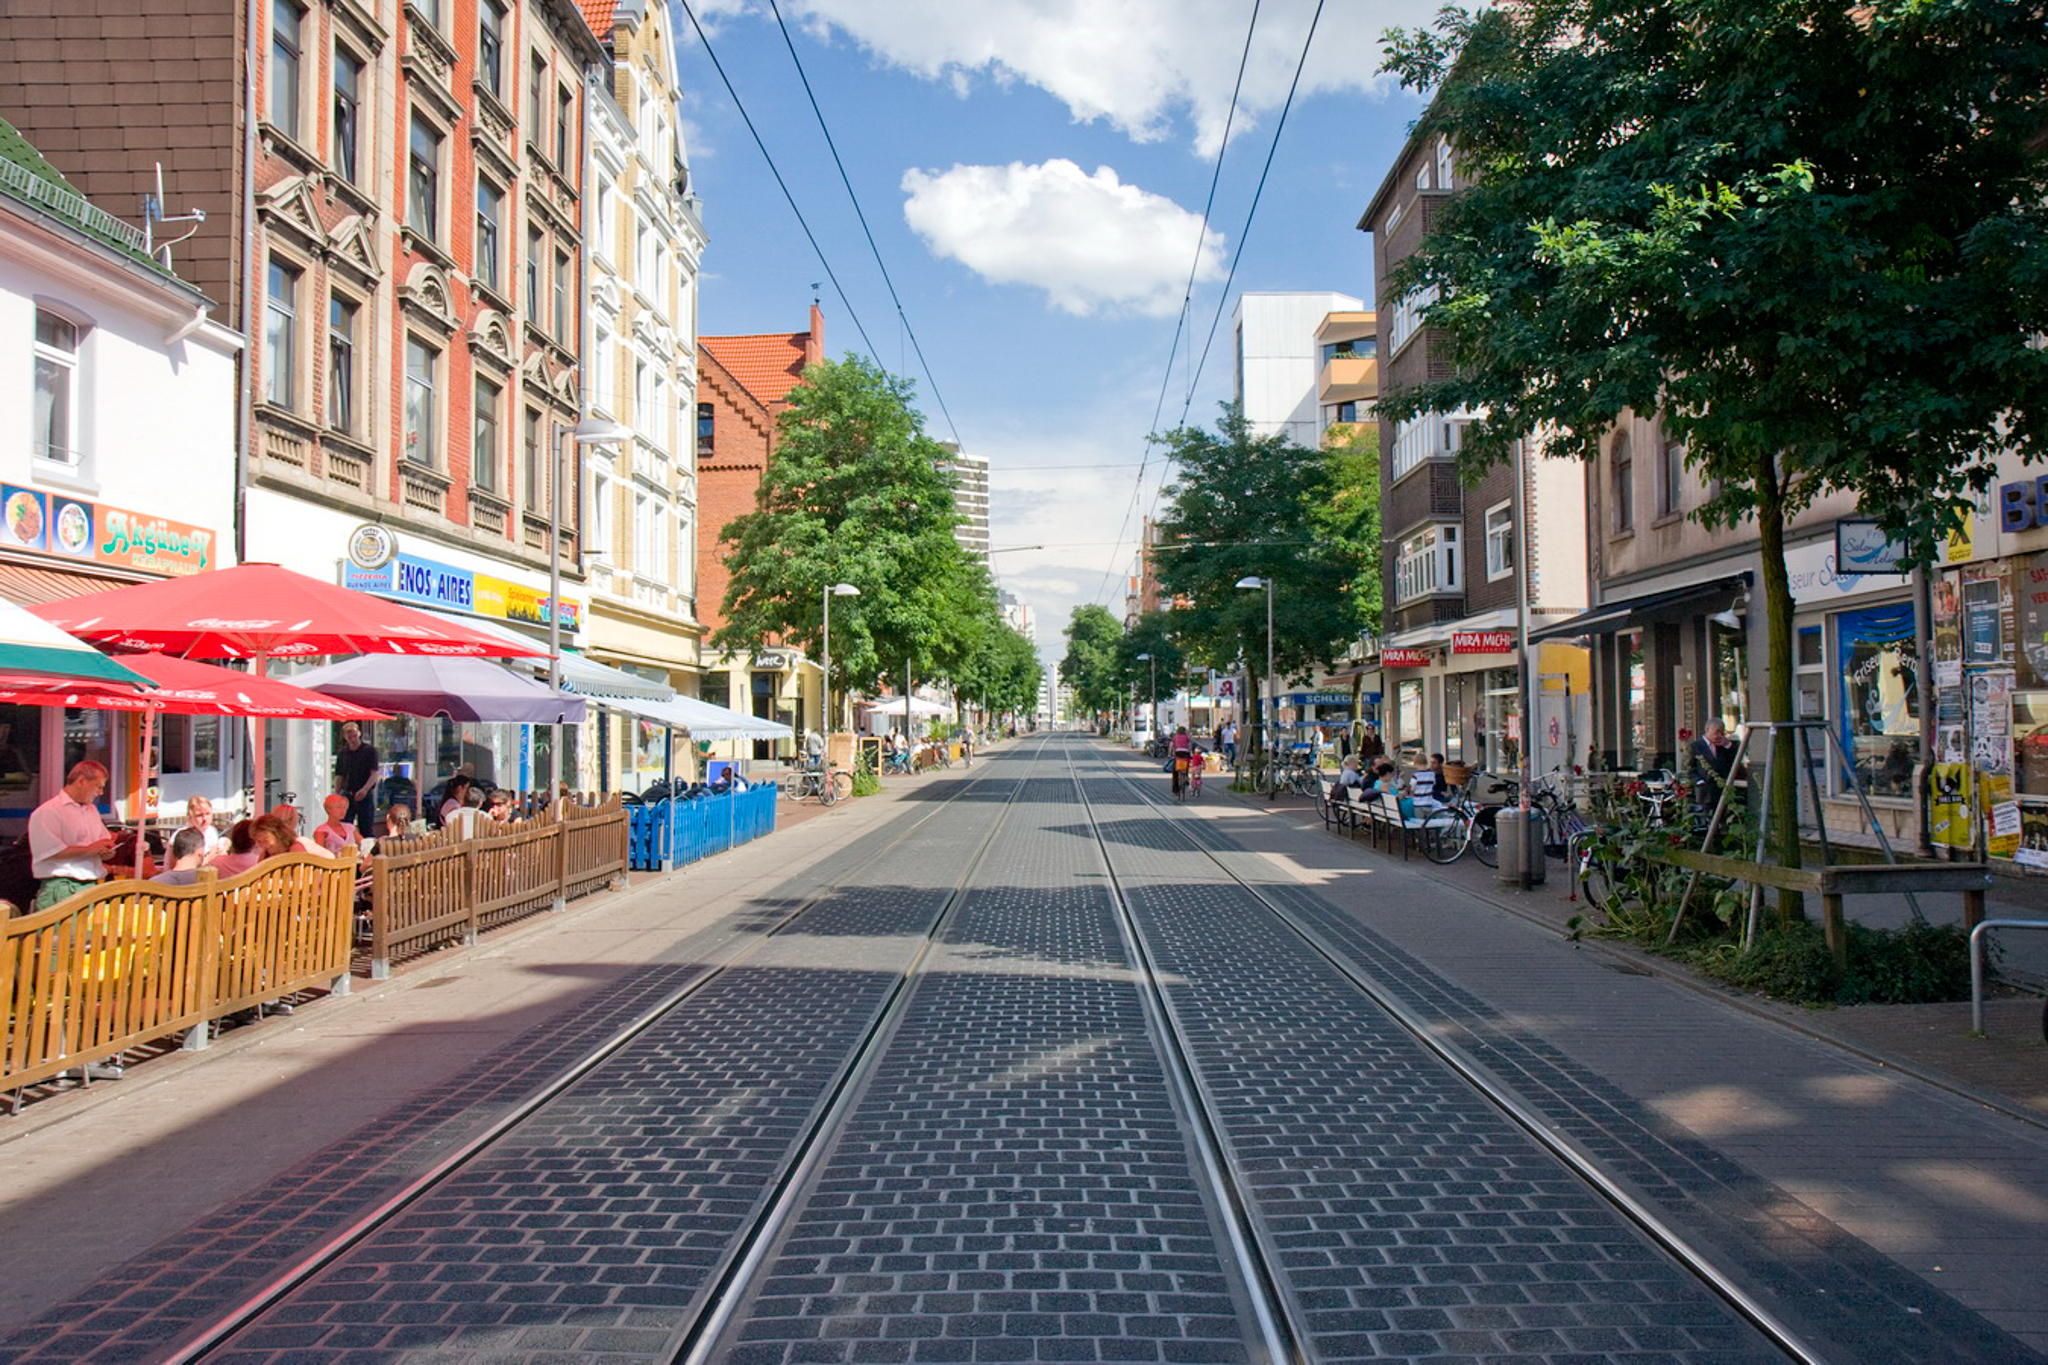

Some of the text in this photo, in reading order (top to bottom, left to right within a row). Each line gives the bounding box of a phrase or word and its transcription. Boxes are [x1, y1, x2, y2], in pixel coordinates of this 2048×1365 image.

[1866, 529, 1886, 540] Fris
[401, 563, 431, 597] ENOS
[437, 573, 471, 605] AIRES
[1454, 633, 1480, 648] MIRA
[1383, 650, 1404, 661] MIRA
[1305, 693, 1371, 704] SCHLECR
